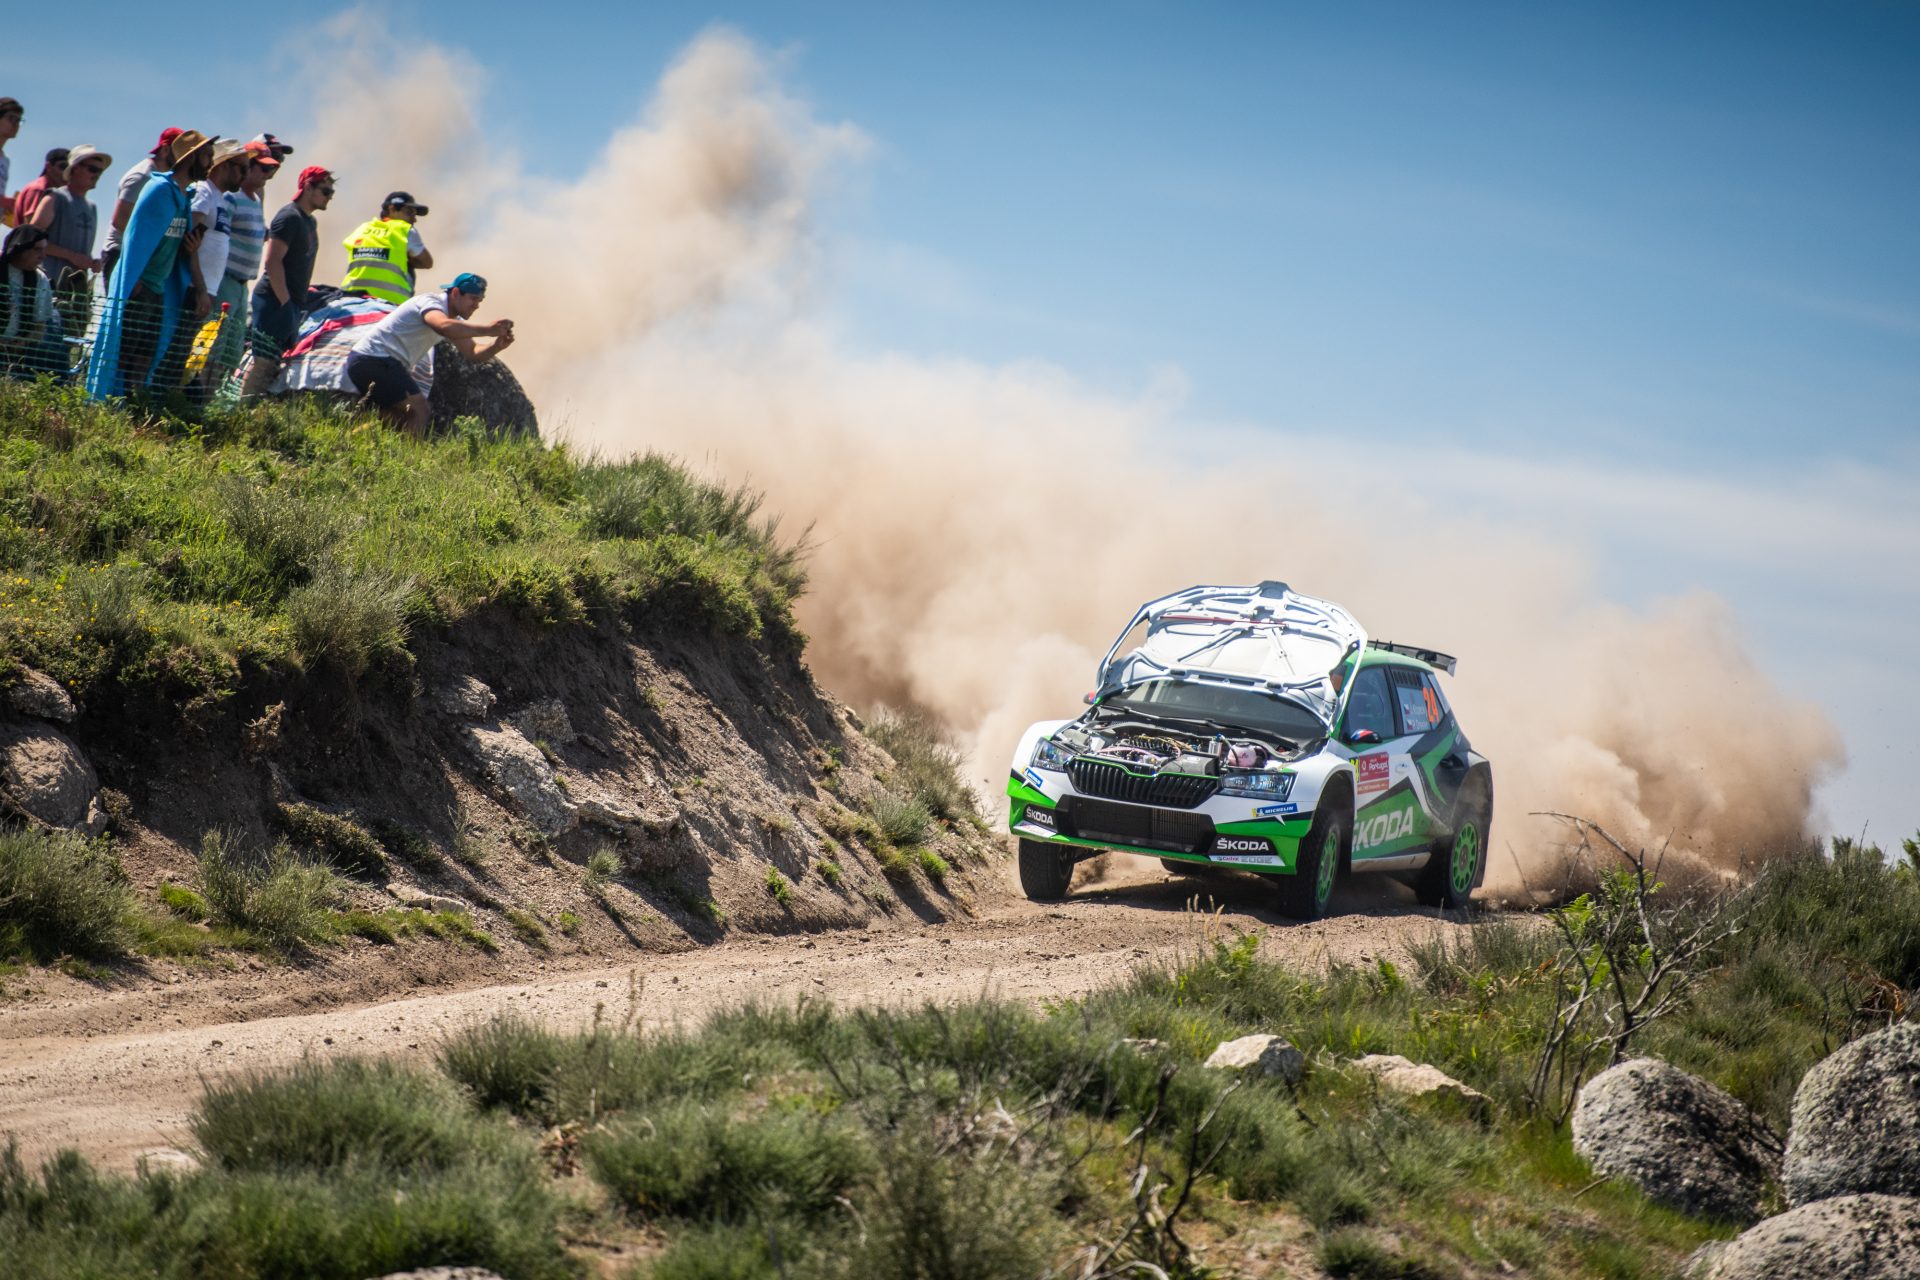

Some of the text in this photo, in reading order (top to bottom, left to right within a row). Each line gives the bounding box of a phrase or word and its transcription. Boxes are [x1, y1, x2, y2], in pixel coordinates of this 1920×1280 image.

[1422, 687, 1440, 723] 24
[1026, 807, 1053, 825] ŠKODA
[1264, 806, 1294, 814] MICHELIN
[1217, 838, 1269, 851] ŠKODA
